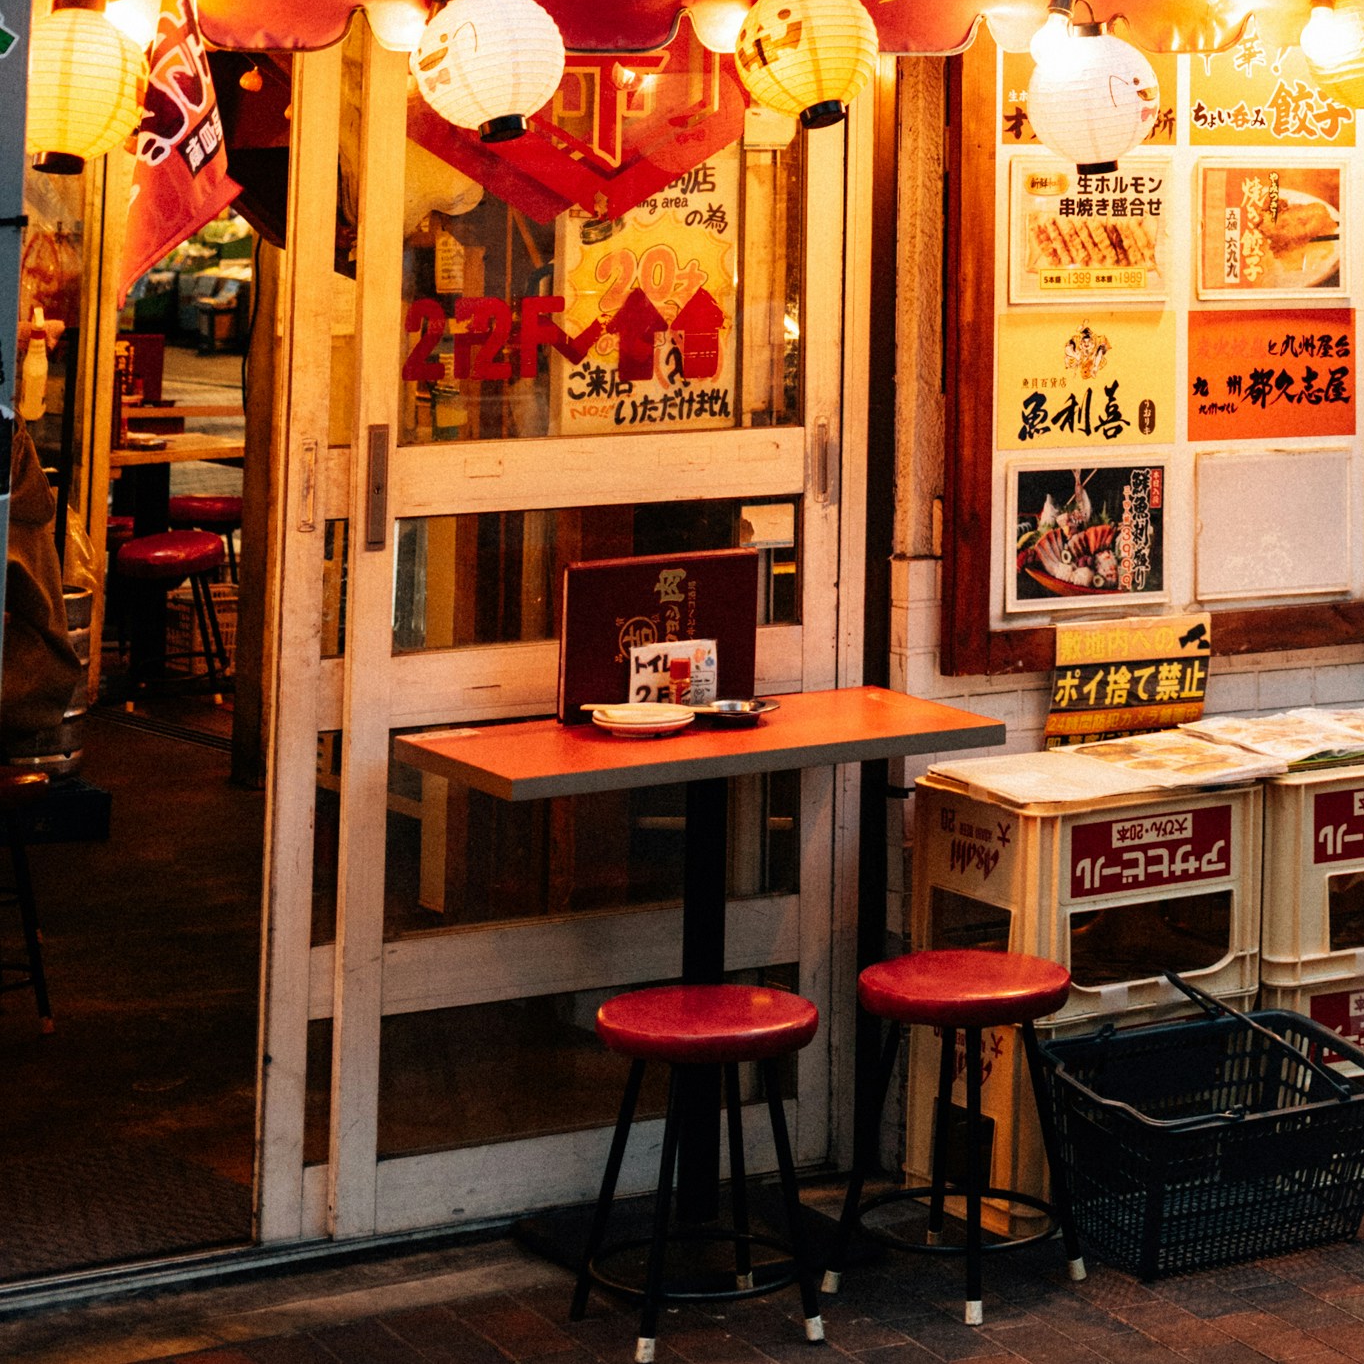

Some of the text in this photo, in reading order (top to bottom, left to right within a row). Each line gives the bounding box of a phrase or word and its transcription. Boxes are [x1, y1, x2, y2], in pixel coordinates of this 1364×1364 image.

[1077, 176, 1163, 195] 生ホルモン
[1059, 197, 1163, 217] 串焼き盛合せ
[614, 389, 731, 425] いただけません
[1018, 379, 1131, 442] 魚利喜
[1055, 660, 1206, 708] ポイ捨て禁止
[1075, 838, 1226, 890] アサヒビール
